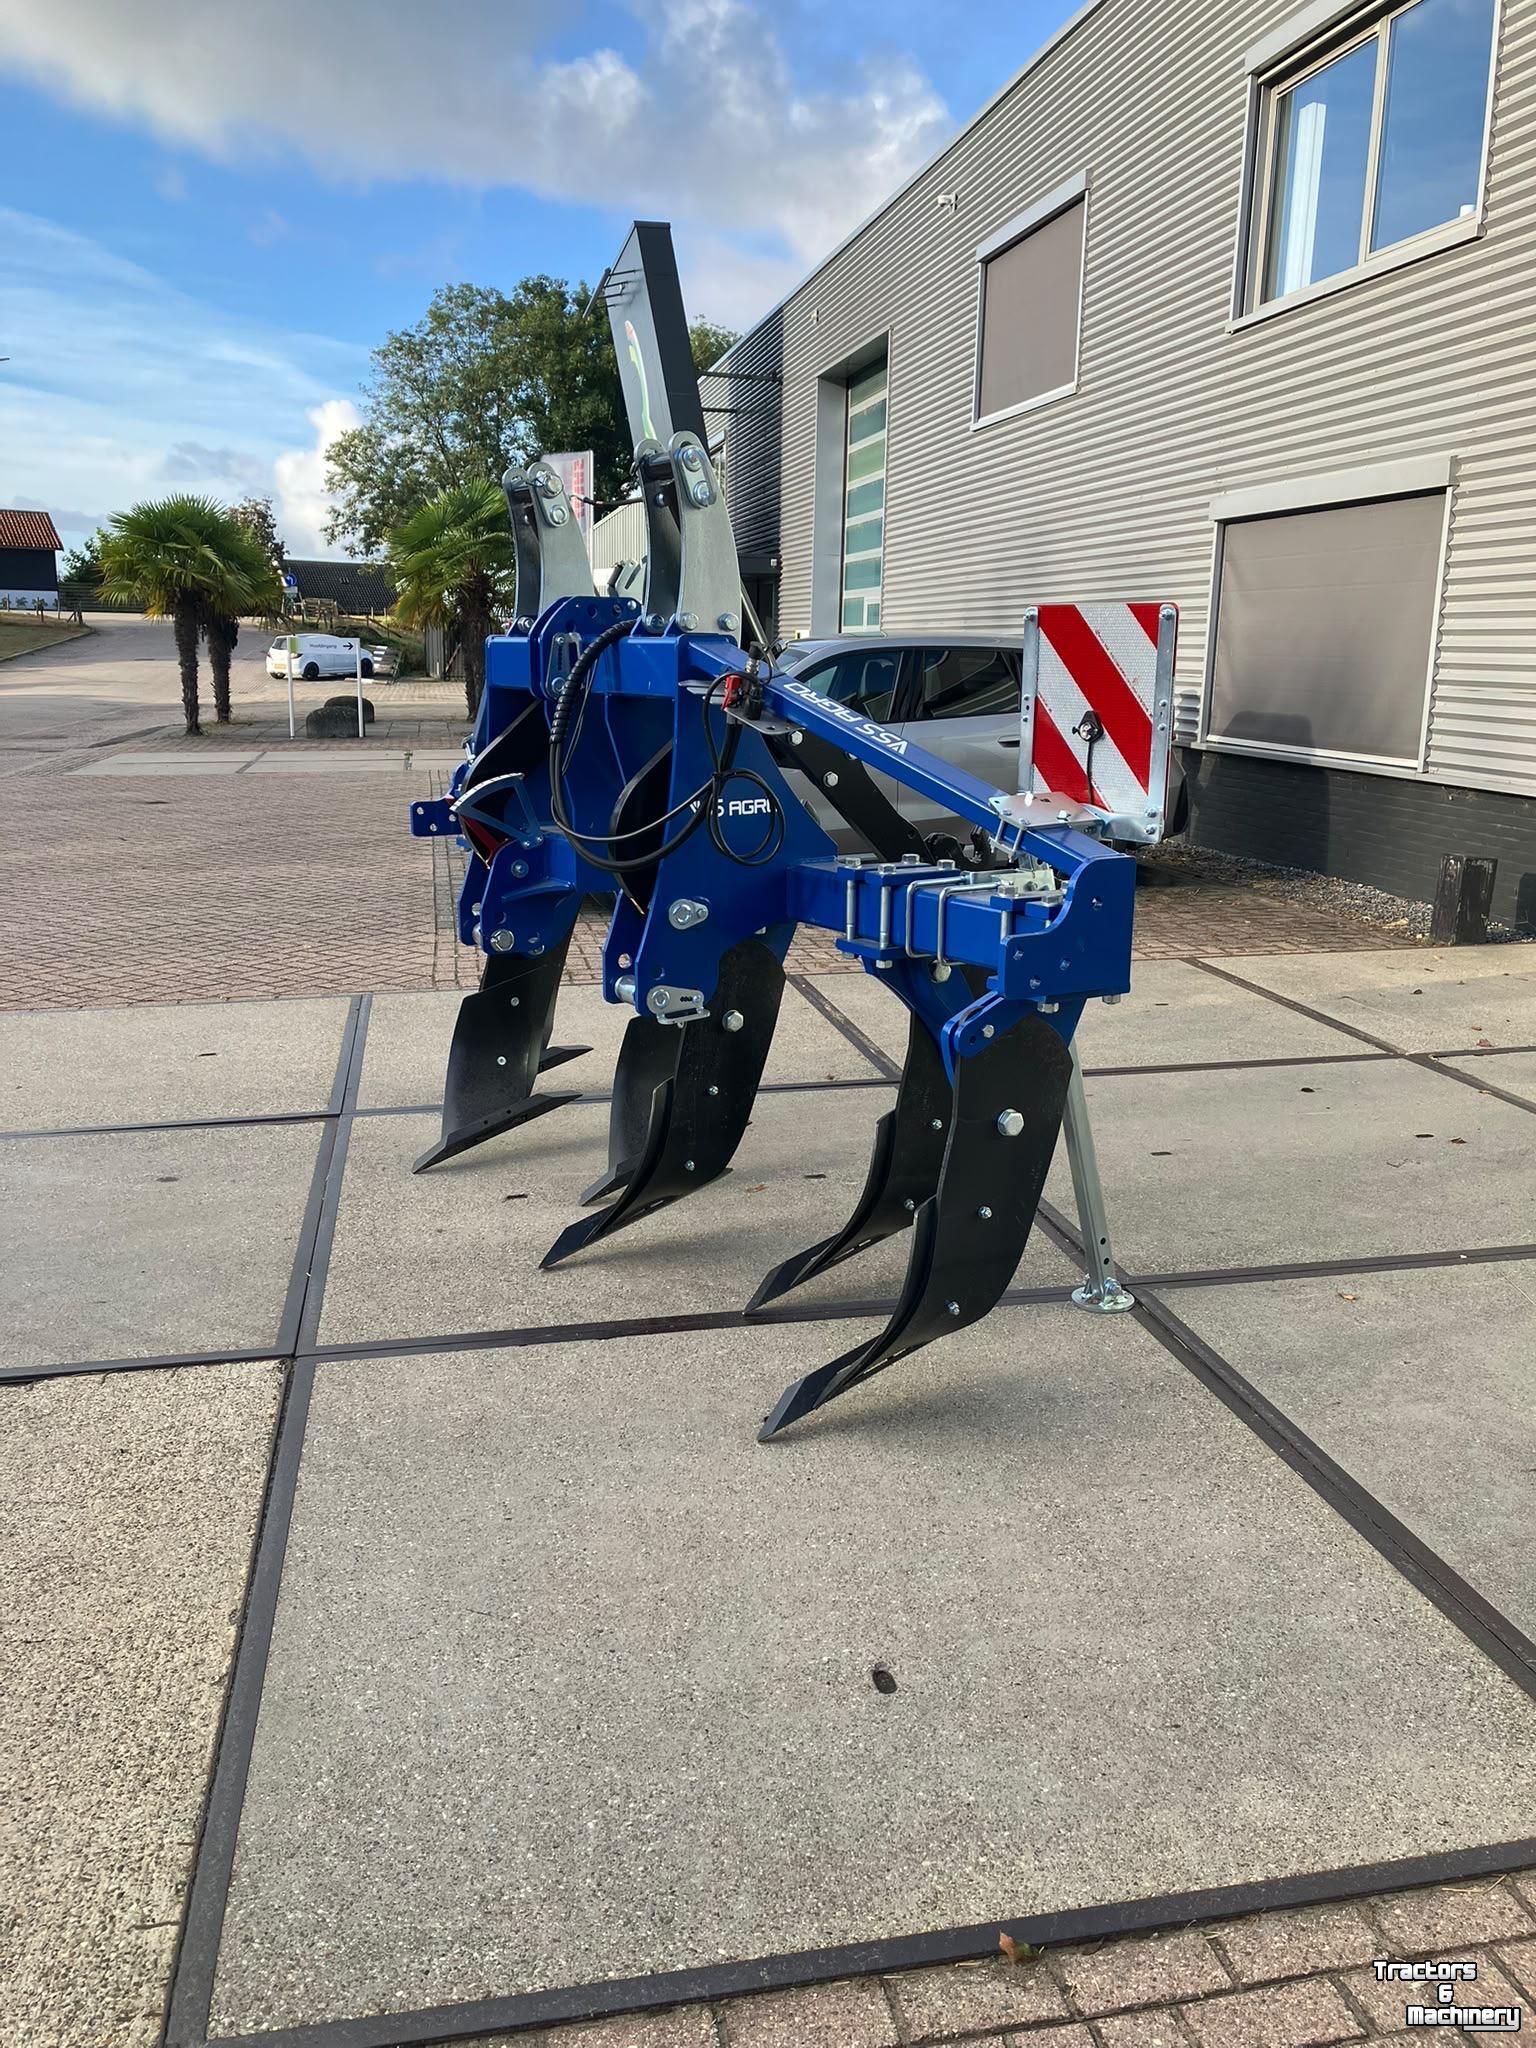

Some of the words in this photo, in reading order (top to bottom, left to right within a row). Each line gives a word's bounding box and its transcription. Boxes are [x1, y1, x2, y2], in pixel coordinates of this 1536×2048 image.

[784, 683, 863, 722] AGRO
[854, 724, 908, 755] VSS
[690, 799, 725, 816] VS
